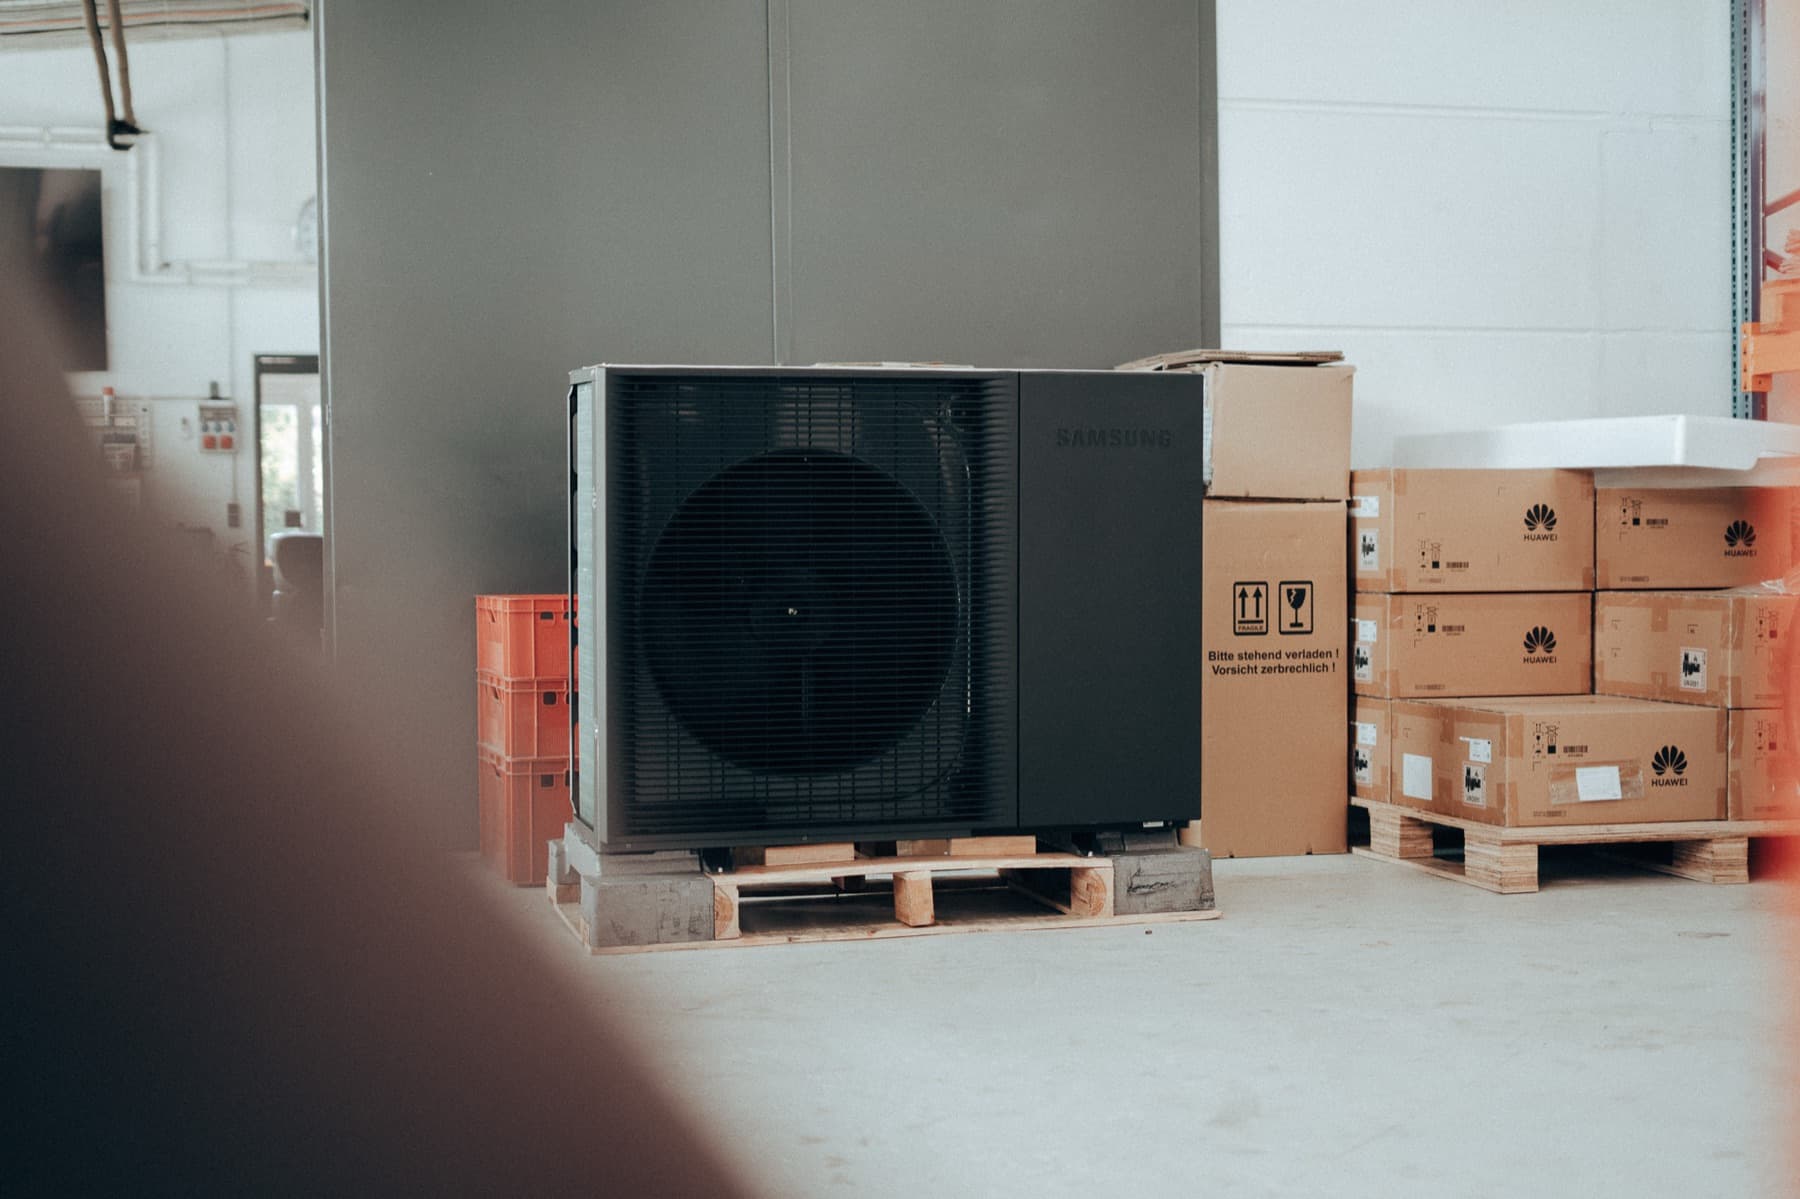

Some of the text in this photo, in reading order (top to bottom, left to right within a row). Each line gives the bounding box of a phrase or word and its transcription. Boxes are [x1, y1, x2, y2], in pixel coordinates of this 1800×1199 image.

[1056, 428, 1172, 448] SAMSUNG
[1208, 651, 1234, 661] Bitte
[1237, 650, 1282, 660] stehend
[1285, 649, 1333, 659] verladen
[1523, 656, 1557, 664] HUAWEI
[1212, 664, 1258, 675] Vorsicht
[1261, 662, 1329, 674] zerbrechlich
[1651, 778, 1688, 787] HUAWEI
